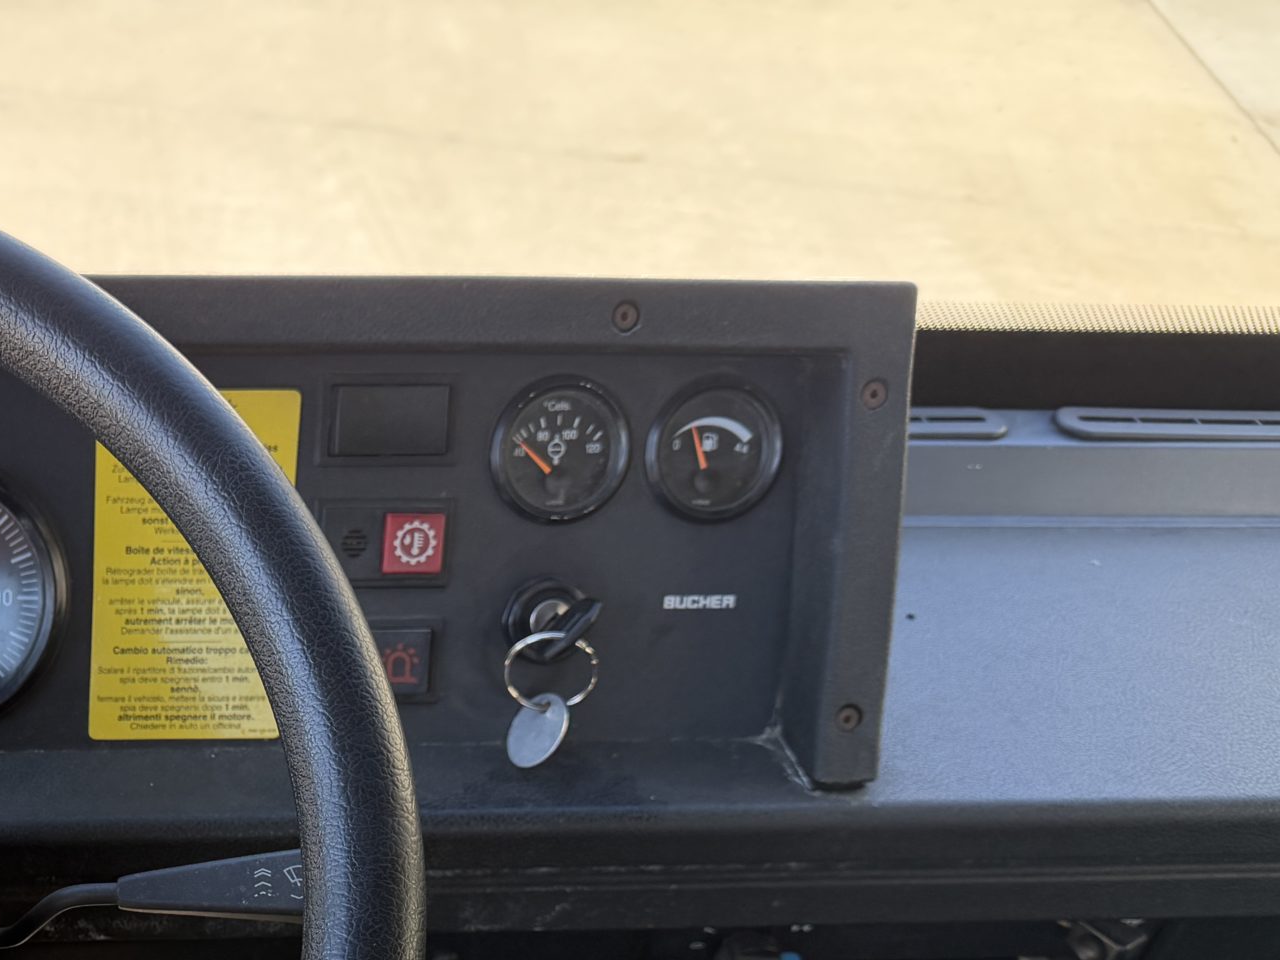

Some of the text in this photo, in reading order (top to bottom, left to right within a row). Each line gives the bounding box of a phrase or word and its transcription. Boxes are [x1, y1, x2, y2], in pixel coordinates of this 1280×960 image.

[662, 594, 737, 610] BUCHER
[112, 646, 149, 655] Cambio
[151, 646, 204, 655] automatico
[205, 646, 237, 657] troppo
[163, 713, 208, 724] spegnere
